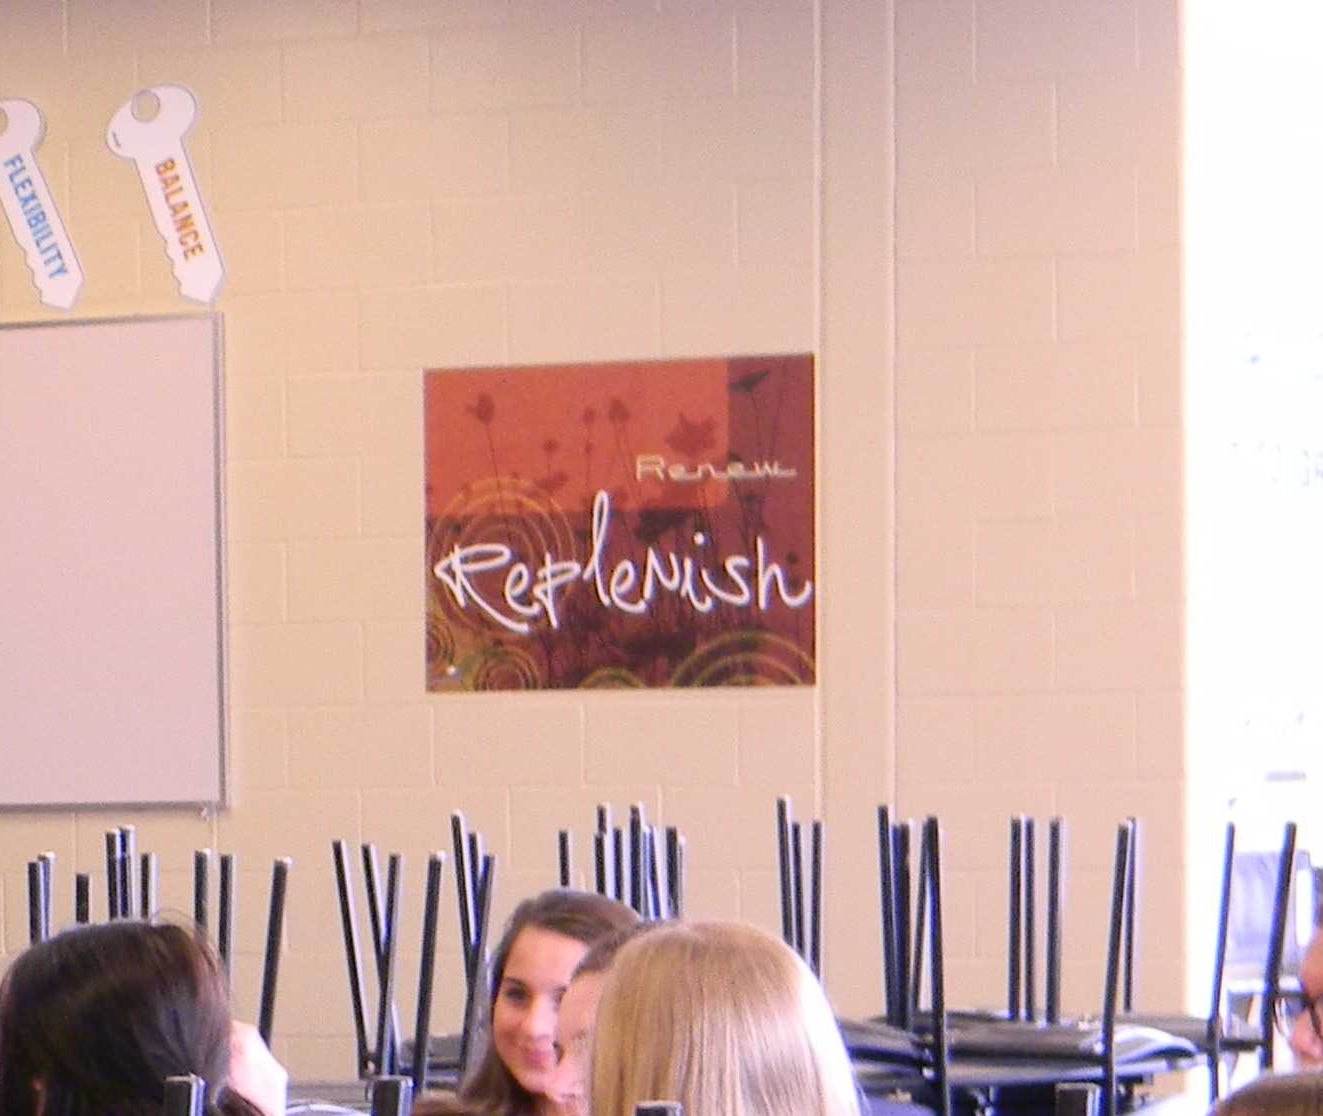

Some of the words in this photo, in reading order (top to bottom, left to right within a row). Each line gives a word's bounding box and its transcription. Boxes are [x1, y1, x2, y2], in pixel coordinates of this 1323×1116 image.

[3, 154, 68, 279] FLEXIBILITY
[156, 158, 204, 260] BALANCE
[636, 454, 797, 481] Renew
[434, 490, 812, 634] Replenish
